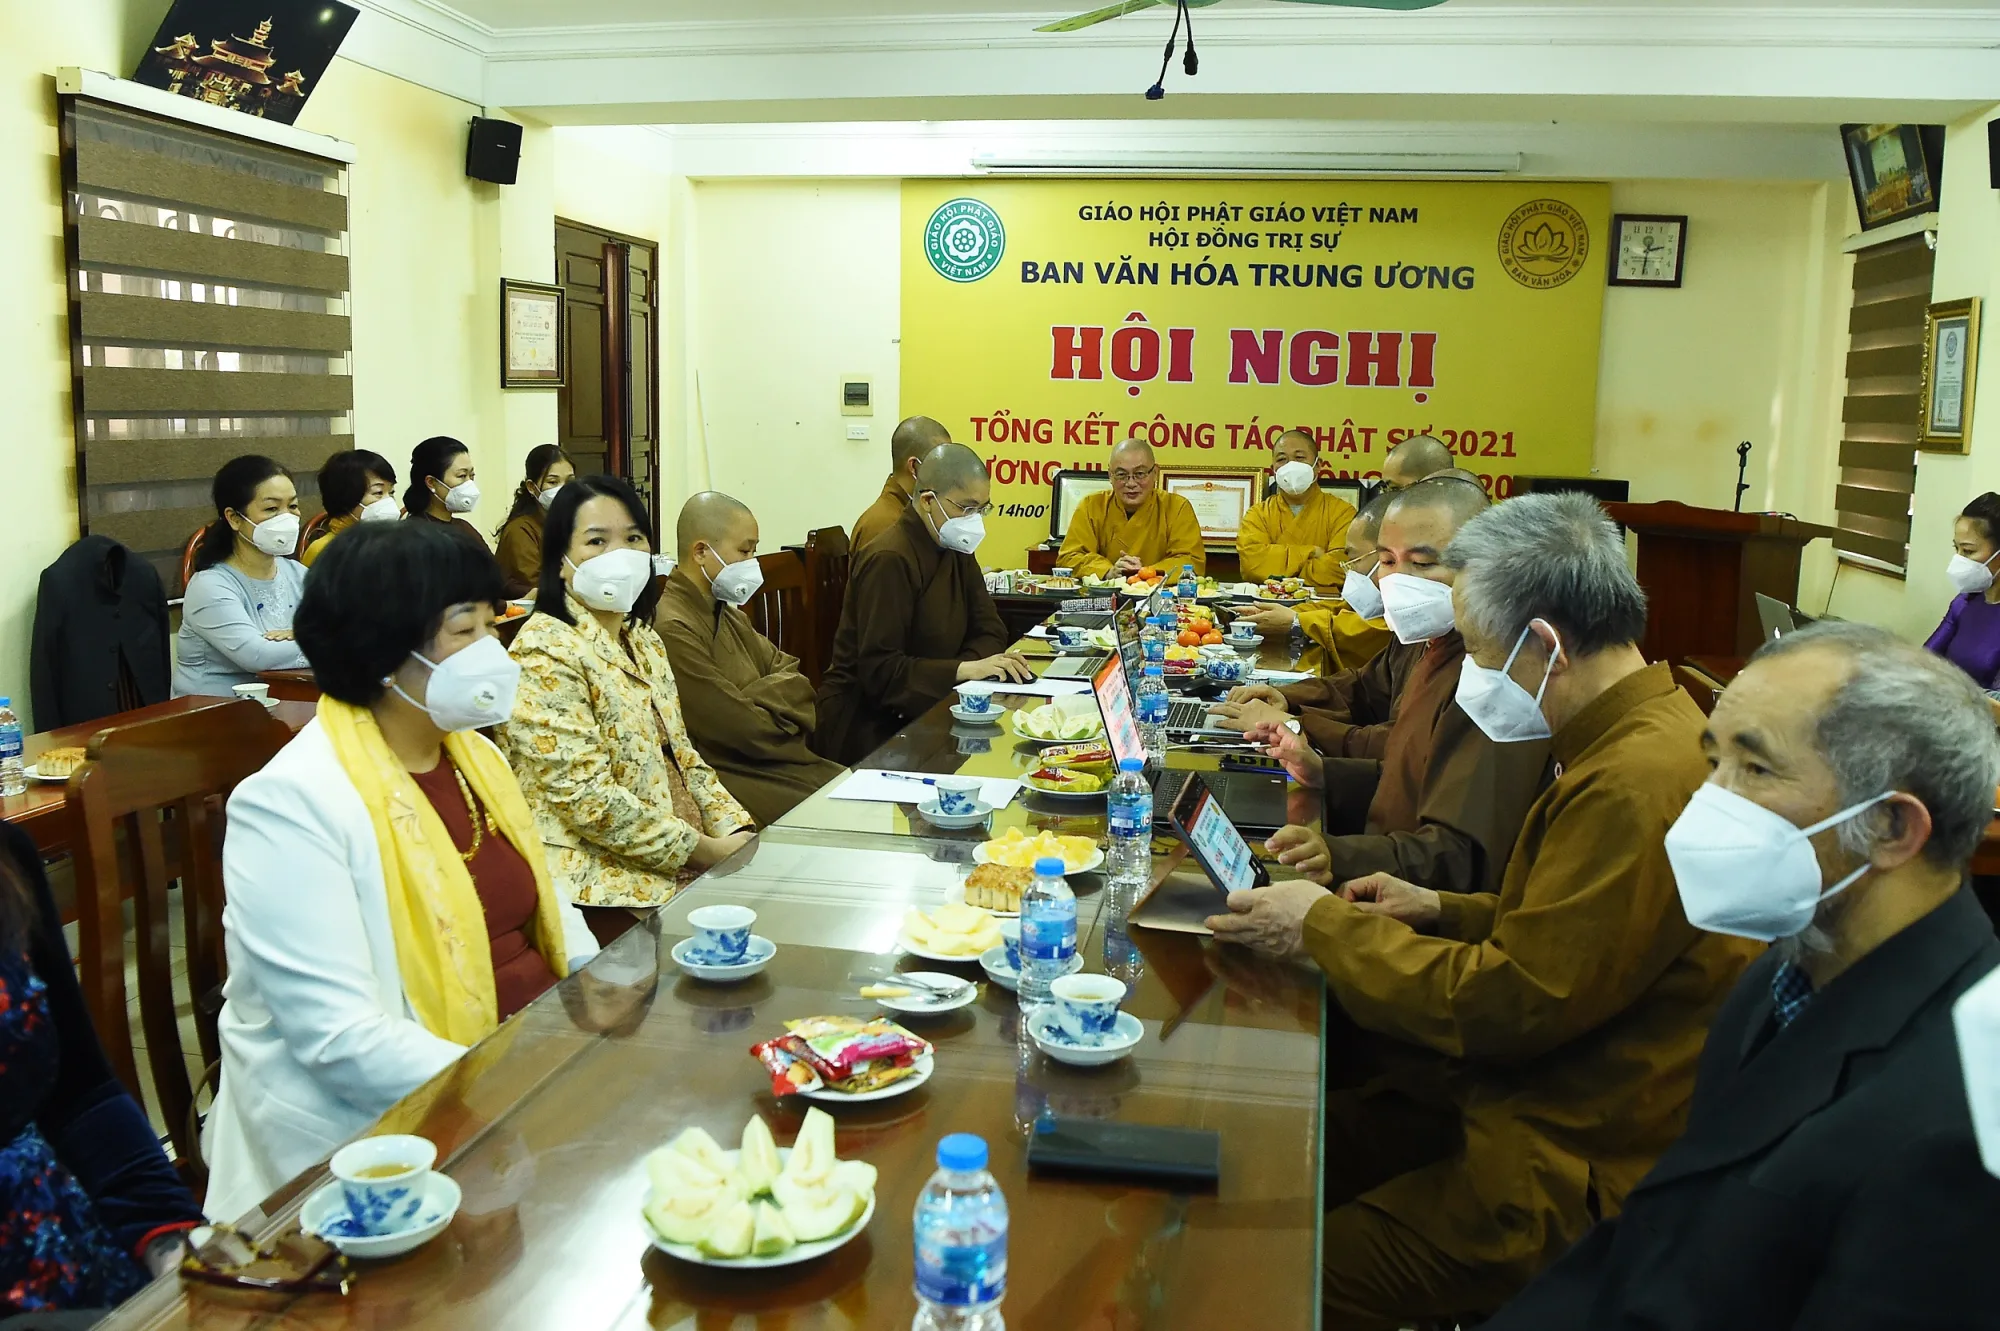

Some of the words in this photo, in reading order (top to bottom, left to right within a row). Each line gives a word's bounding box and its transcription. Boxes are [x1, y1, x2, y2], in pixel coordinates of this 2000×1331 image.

[930, 223, 941, 250] GIÁO
[940, 207, 957, 222] HỘI
[961, 205, 988, 219] PHẬT
[987, 220, 1000, 248] GIÁO
[1079, 201, 1133, 222] GIÁO
[1140, 201, 1180, 225] HỘI
[1187, 201, 1243, 226] PHẬT
[1250, 202, 1305, 223] GIÁO
[1312, 202, 1363, 227] VIỆT
[1369, 207, 1418, 223] NAM
[1150, 228, 1189, 250] HỘI
[1196, 227, 1258, 248] ĐỒNG
[1265, 233, 1303, 252] TRỊ
[1310, 231, 1341, 252] SỰ
[941, 261, 962, 276] VIỆT
[965, 261, 988, 276] NAM
[1021, 261, 1084, 284] BAN
[1094, 255, 1158, 285] VĂN
[1171, 256, 1239, 286] HÓA
[1249, 264, 1362, 289] TRUNG
[1374, 261, 1474, 290] ƯƠNG
[1050, 311, 1195, 397] HỘI
[1228, 329, 1438, 404] NGHỊ
[970, 410, 1053, 444] TỔNG
[1063, 411, 1120, 446] KẾT
[1128, 413, 1215, 449] CÔNG
[1442, 429, 1517, 458] 2021
